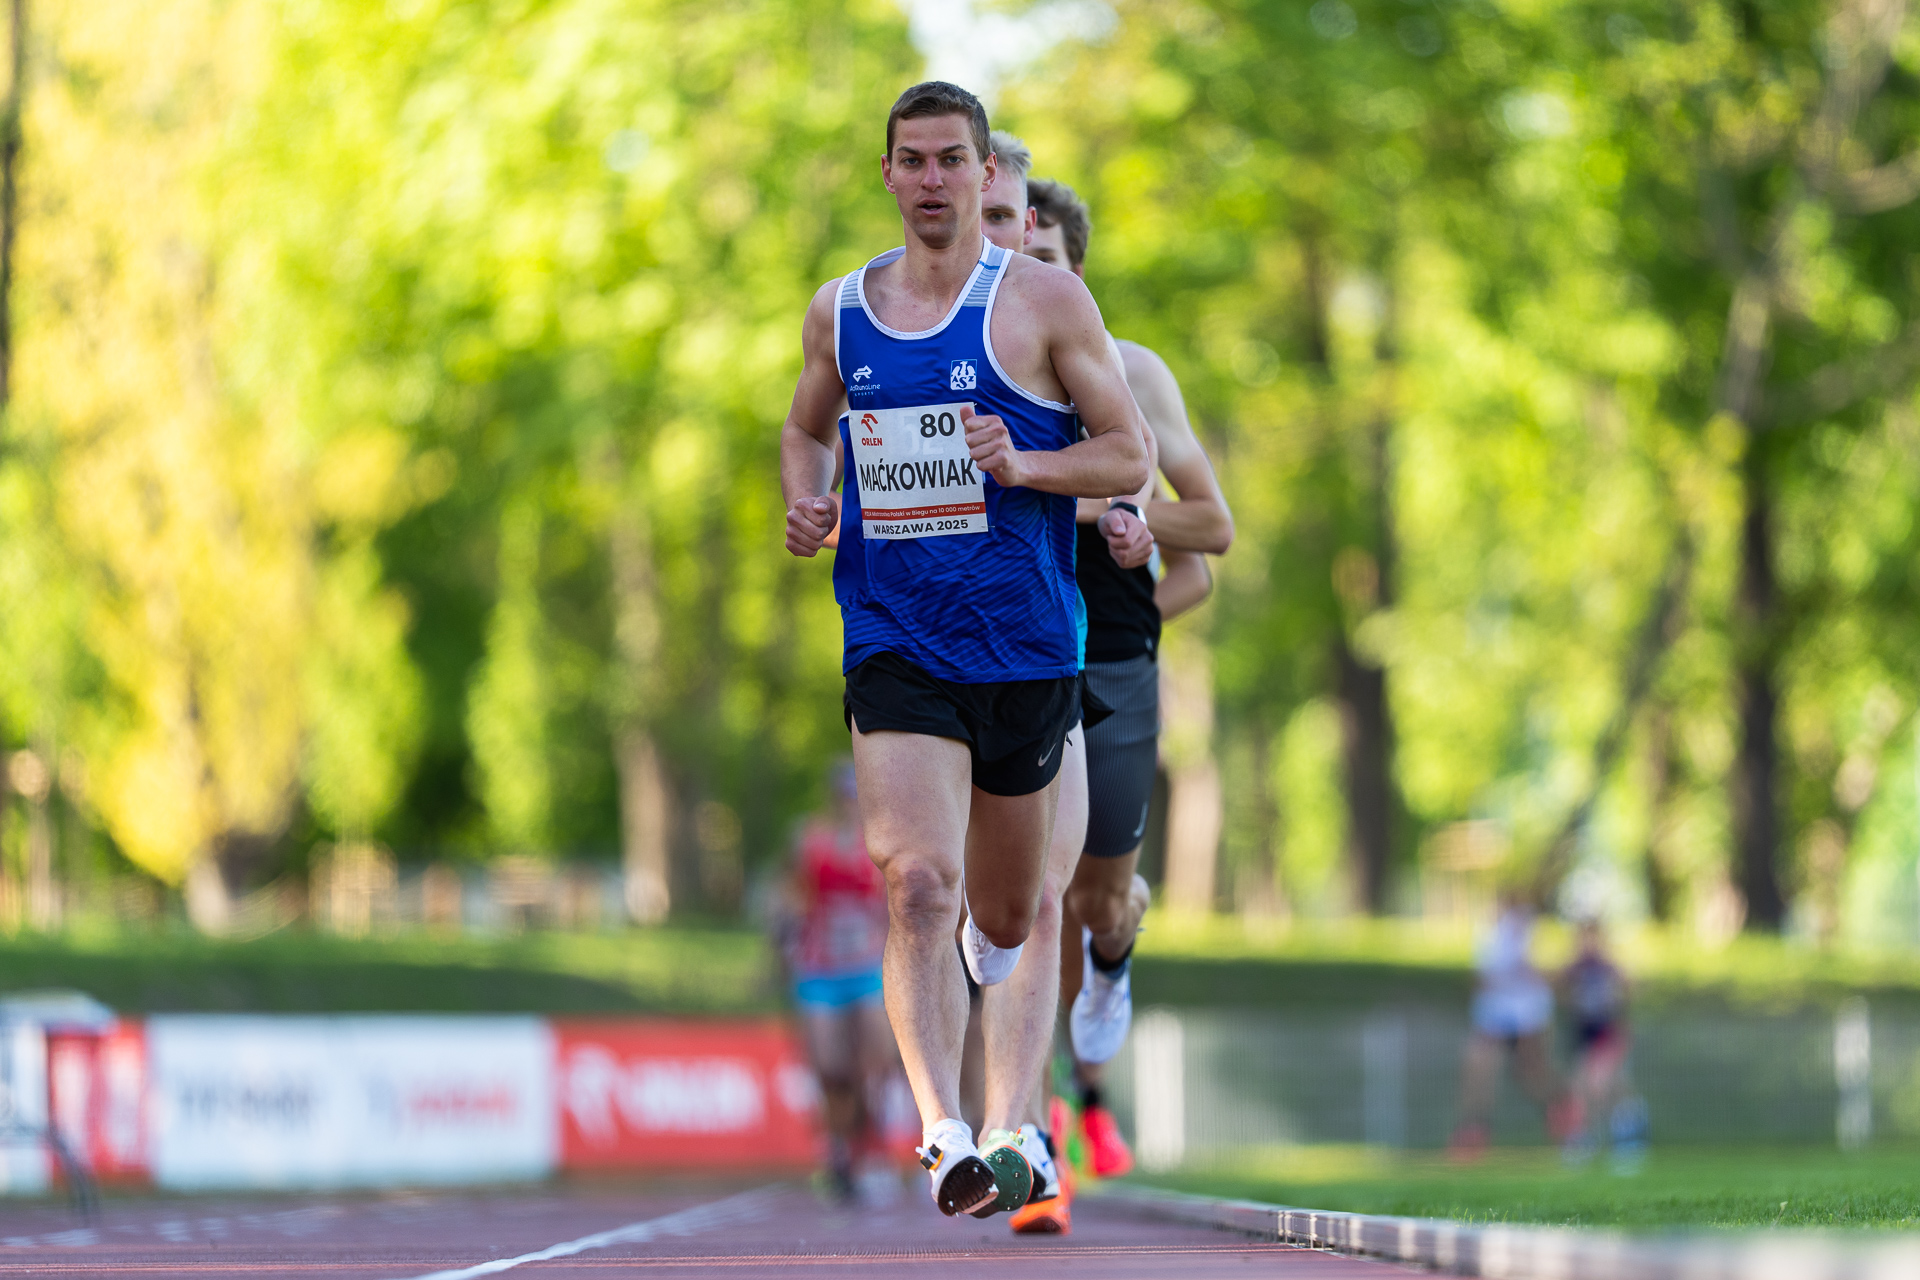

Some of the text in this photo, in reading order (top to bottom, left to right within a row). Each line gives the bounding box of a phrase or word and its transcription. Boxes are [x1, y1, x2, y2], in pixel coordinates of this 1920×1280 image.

[920, 412, 956, 438] 80
[861, 437, 883, 446] ORLEN
[859, 458, 977, 492] MAĆKOWIAK
[911, 509, 929, 517] Biegu
[873, 519, 969, 535] WARSZAWA 2025
